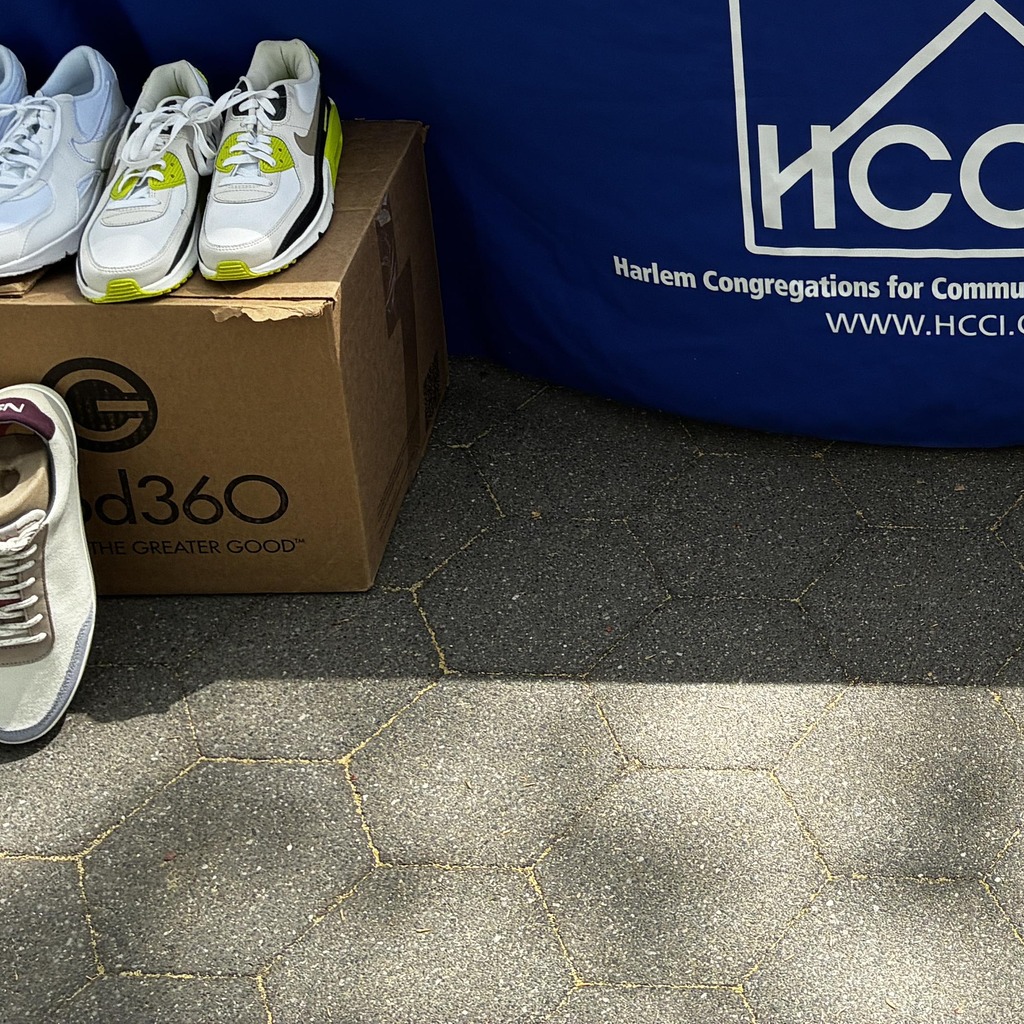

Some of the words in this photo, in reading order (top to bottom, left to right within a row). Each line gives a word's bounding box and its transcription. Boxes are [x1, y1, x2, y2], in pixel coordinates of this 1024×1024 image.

[613, 256, 697, 289] Harlem
[702, 271, 881, 304] Congregations
[886, 276, 923, 300] for
[91, 541, 126, 555] THE
[132, 540, 221, 554] GREATER
